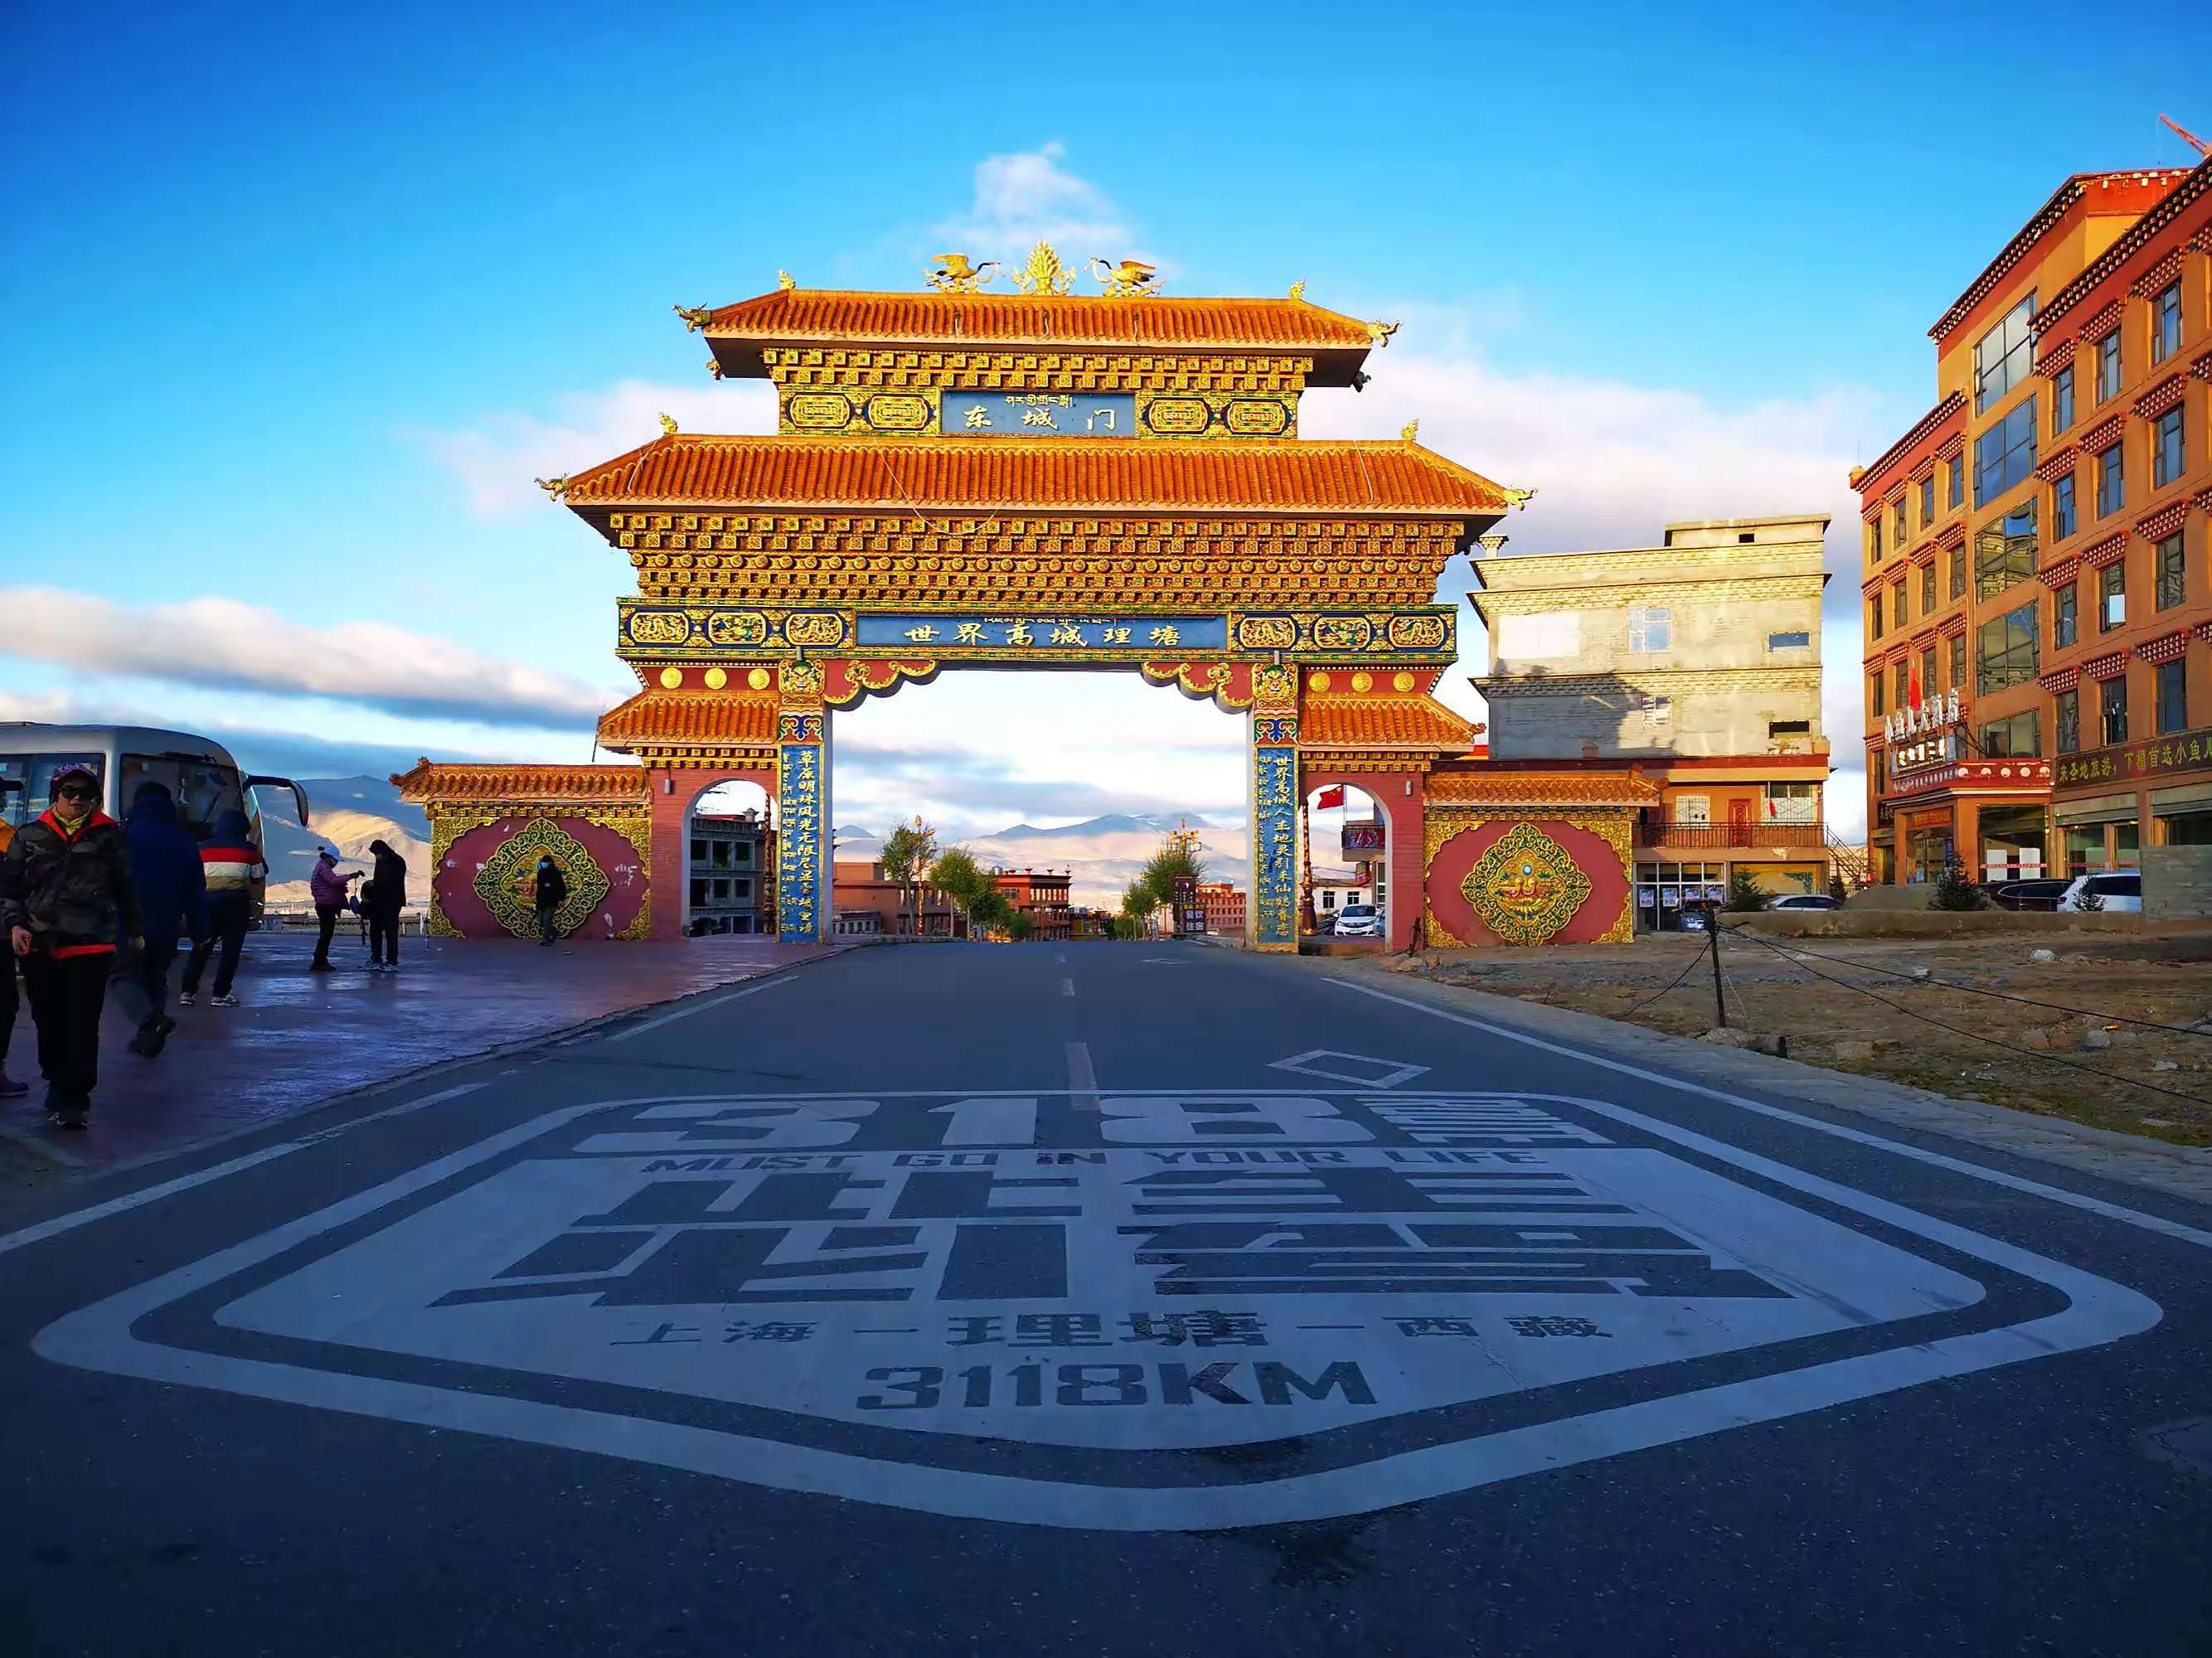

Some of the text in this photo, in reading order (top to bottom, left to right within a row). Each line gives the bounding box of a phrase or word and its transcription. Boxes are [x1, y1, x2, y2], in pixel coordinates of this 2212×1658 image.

[963, 405, 1116, 431] 东城门
[903, 623, 1182, 647] 世界高城理塘
[571, 1097, 1377, 1153] 318
[1355, 1098, 1617, 1145] ROUTE
[638, 1150, 1549, 1173] MUST GO IN YOUR LIFE
[569, 1166, 1639, 1227] 此生
[424, 1221, 1798, 1307] 必驾
[855, 1360, 1380, 1410] 3118KM
